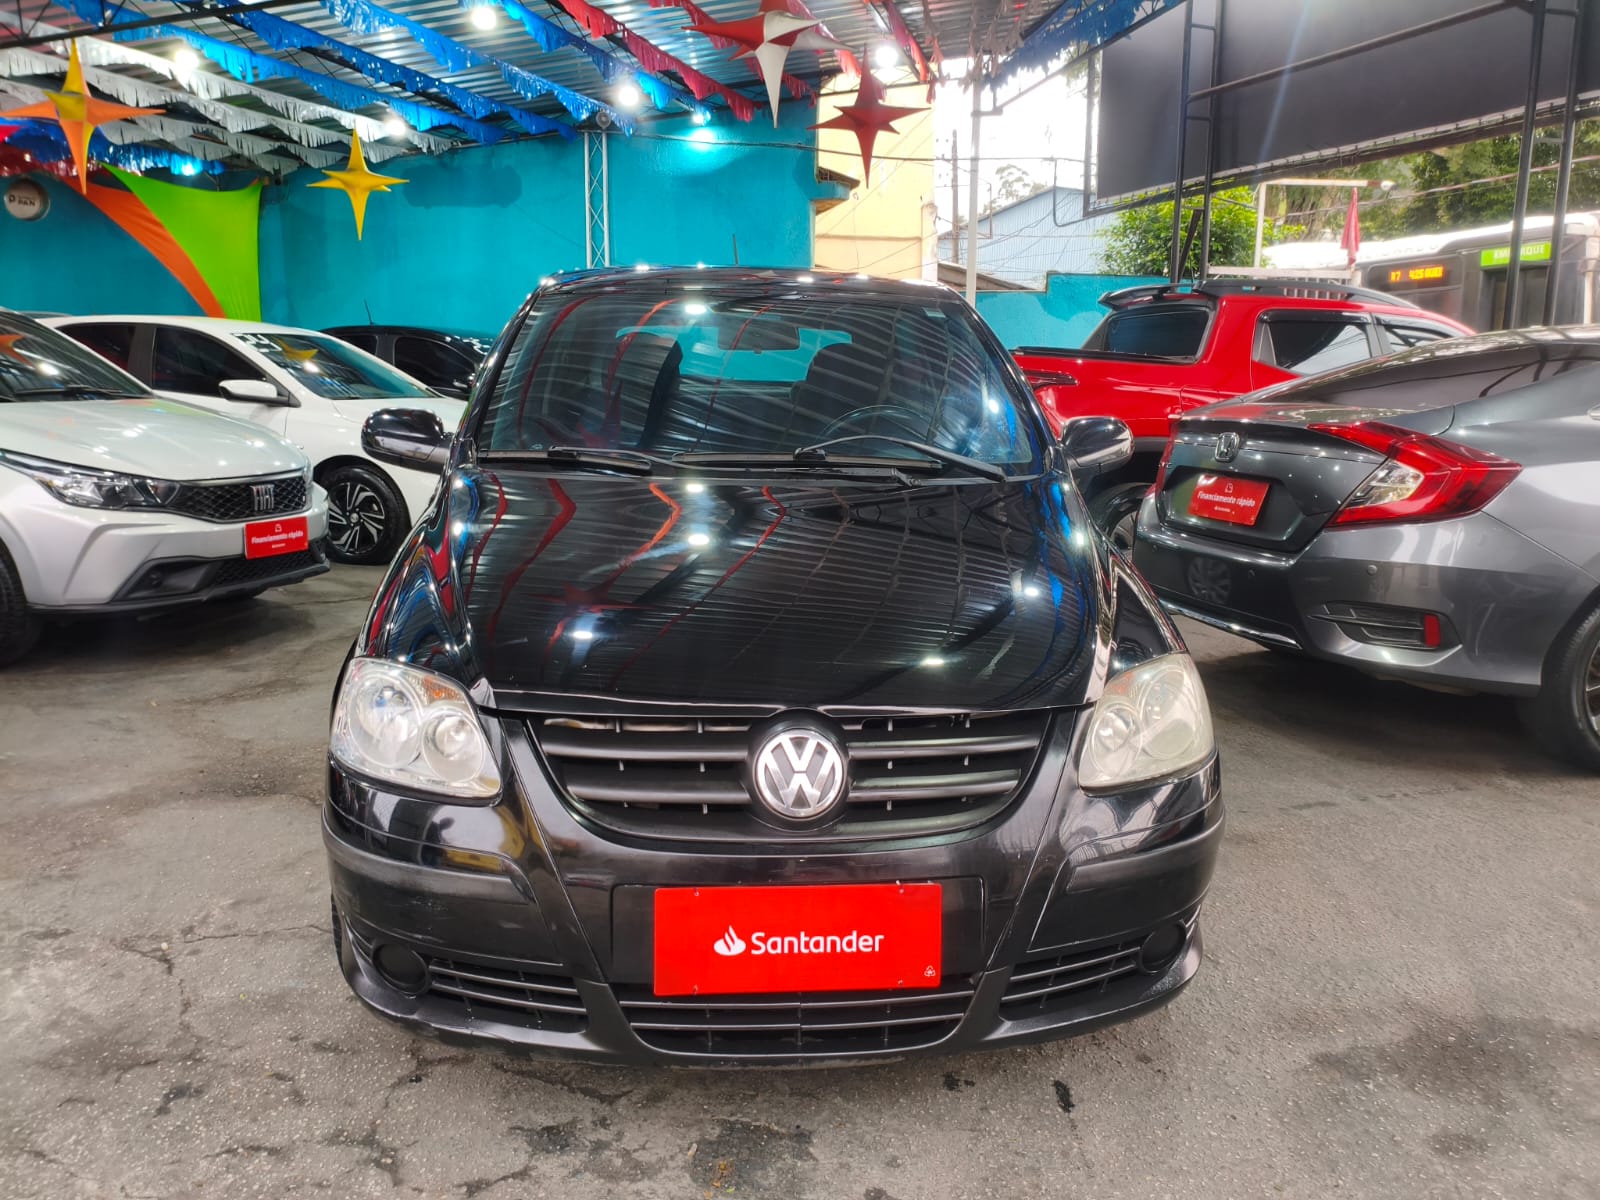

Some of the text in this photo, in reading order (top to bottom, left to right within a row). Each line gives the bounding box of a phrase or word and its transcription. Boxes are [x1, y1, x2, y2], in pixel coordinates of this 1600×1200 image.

[1197, 490, 1236, 505] Financiamento
[757, 729, 842, 818] VW
[750, 930, 885, 955] Santander
